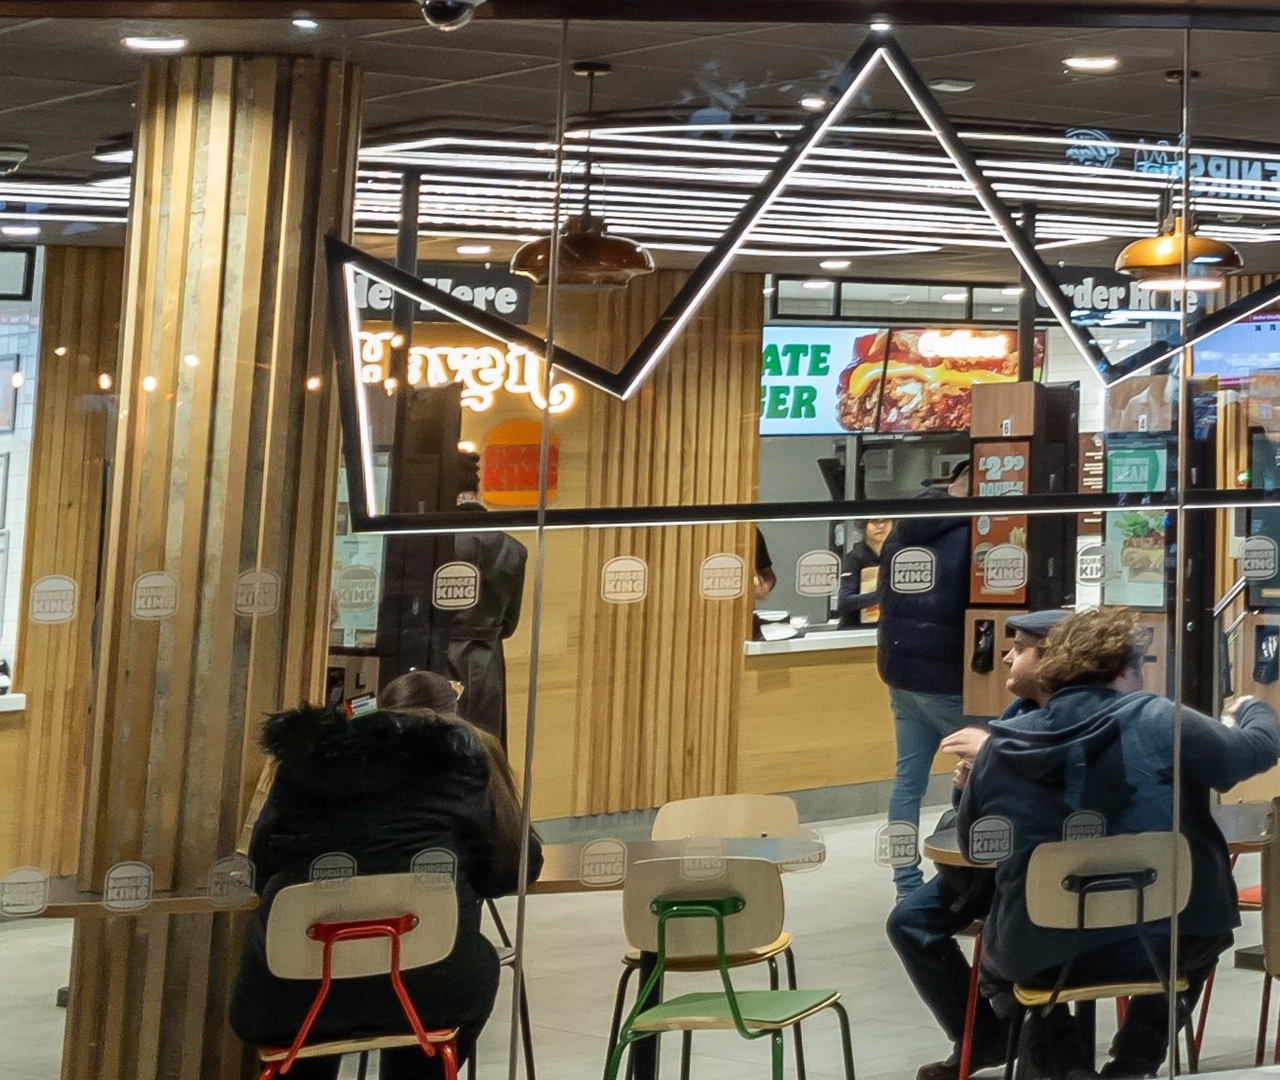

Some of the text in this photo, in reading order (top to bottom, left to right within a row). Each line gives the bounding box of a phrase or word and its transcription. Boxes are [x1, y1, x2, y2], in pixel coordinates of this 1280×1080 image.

[762, 343, 832, 377] ATE
[895, 562, 931, 572] BURGER
[987, 566, 1023, 579] KING
[436, 577, 475, 587] BURGER
[800, 573, 837, 586] KING
[895, 570, 931, 583] KING
[606, 580, 643, 593] KING
[704, 577, 742, 590] KING
[338, 589, 377, 601] KING
[436, 585, 475, 600] KING
[973, 831, 1009, 841] BURGER
[880, 843, 916, 858] KING
[973, 840, 1009, 853] KING
[584, 862, 623, 876] KING
